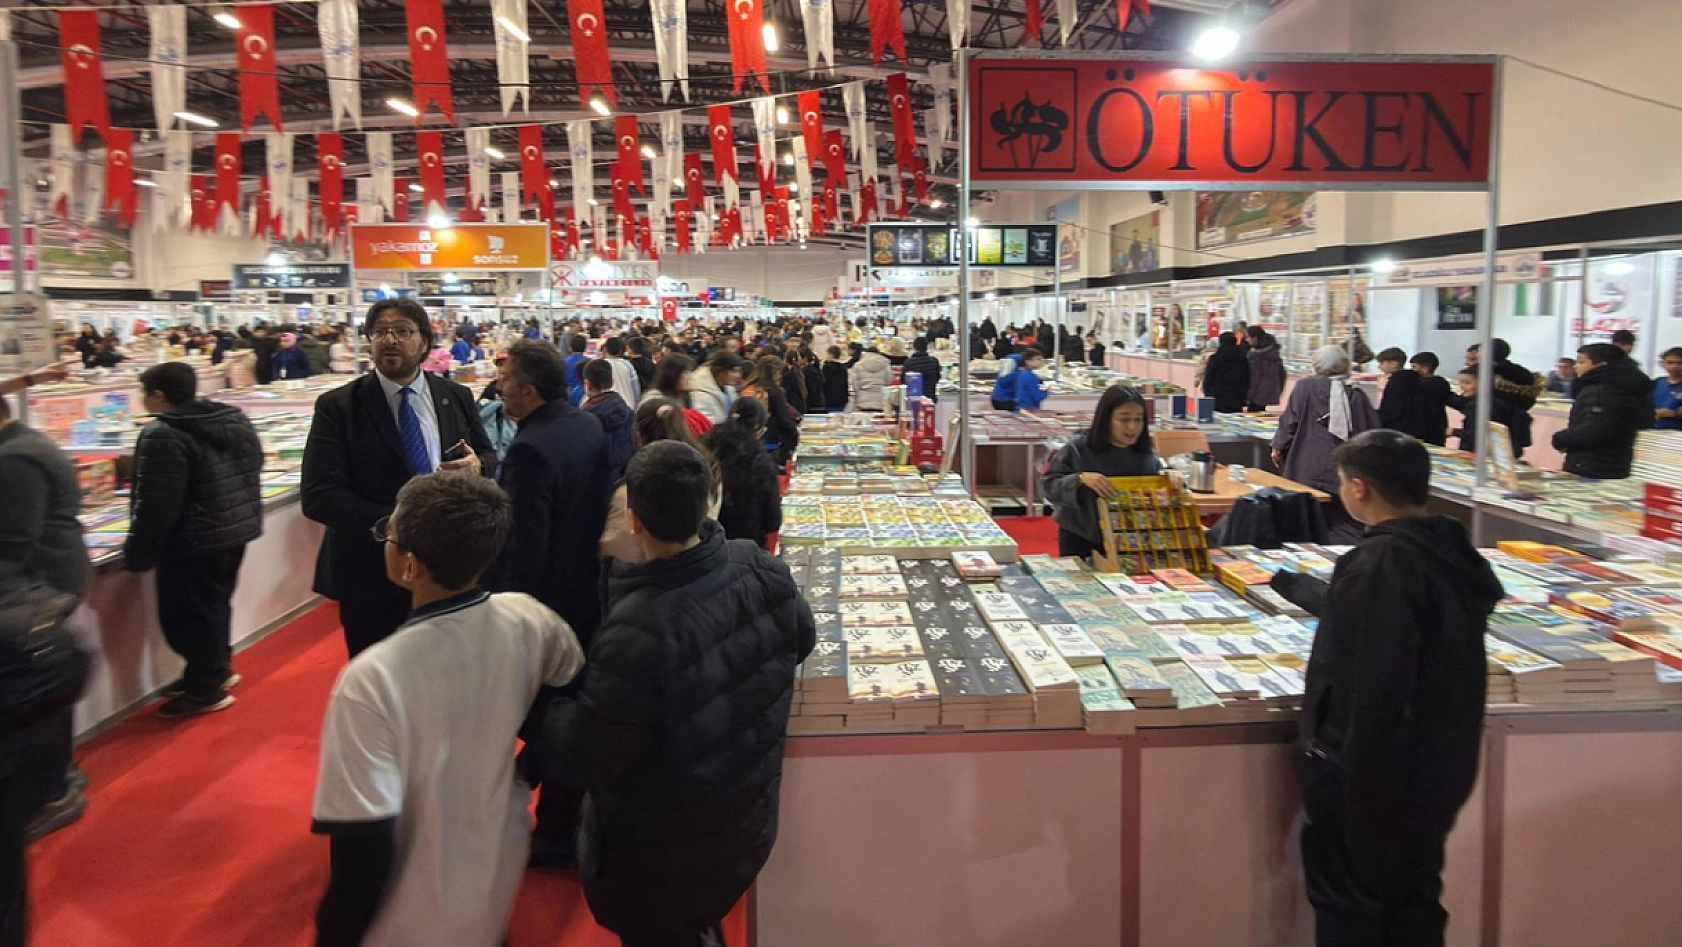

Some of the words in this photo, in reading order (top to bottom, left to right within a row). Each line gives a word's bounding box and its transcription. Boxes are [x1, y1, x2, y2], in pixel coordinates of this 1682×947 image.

[1087, 68, 1484, 173] ÖTÜKEN
[369, 239, 439, 254] yakamoz
[472, 253, 519, 264] sonsuz
